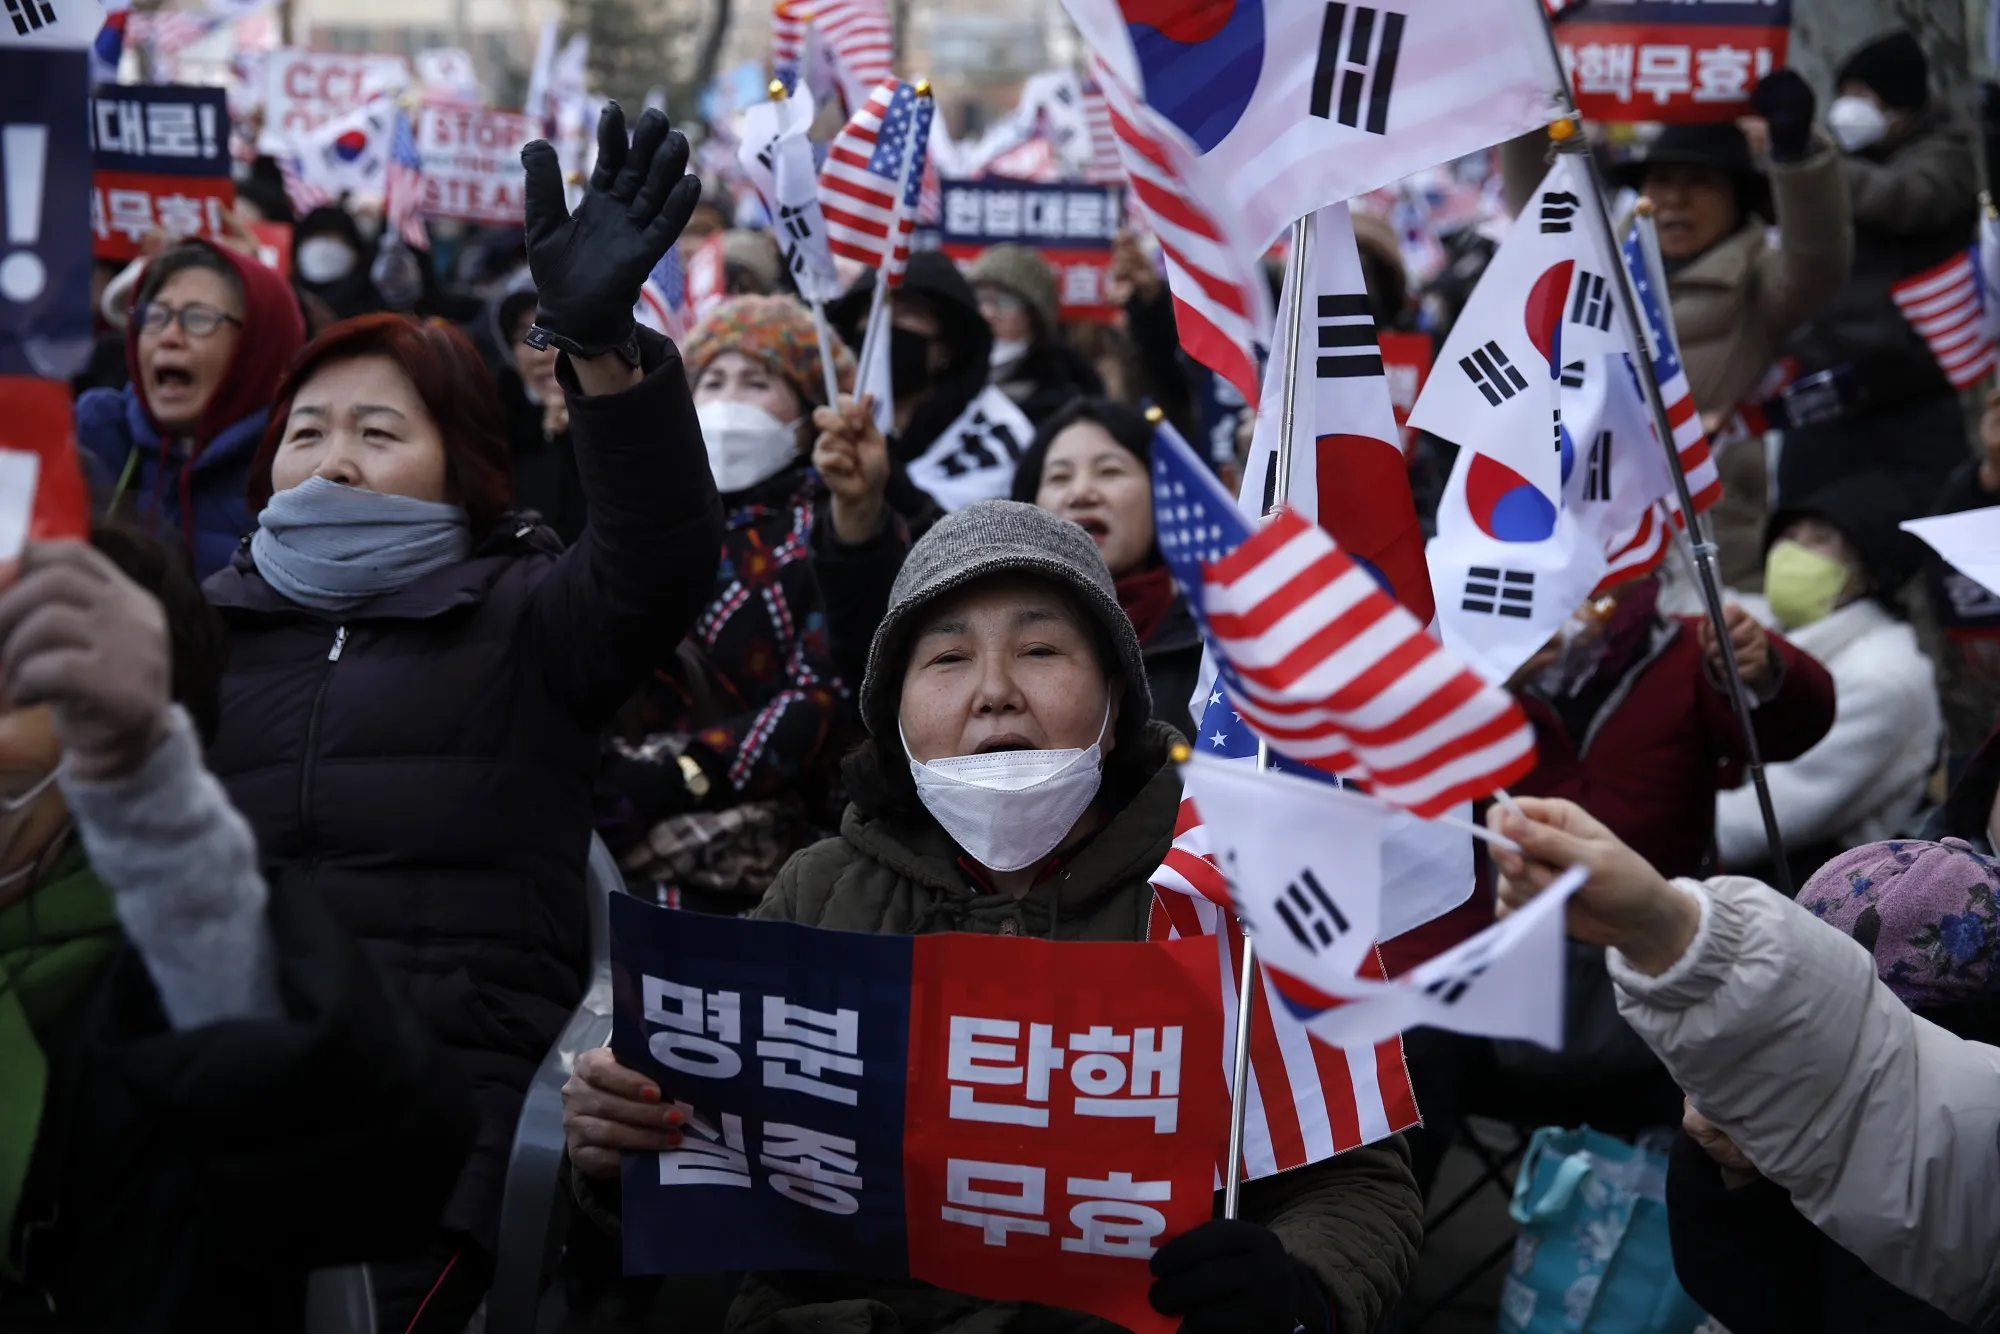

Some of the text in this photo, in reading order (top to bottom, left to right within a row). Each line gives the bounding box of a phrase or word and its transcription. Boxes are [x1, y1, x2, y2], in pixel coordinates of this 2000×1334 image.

[1560, 43, 1773, 104] 핵무효!
[90, 99, 219, 159] 대로!
[424, 178, 526, 210] STEA
[642, 974, 863, 1106] 명분
[948, 1015, 1183, 1134] 탄핵
[941, 1157, 1171, 1260] 무효
